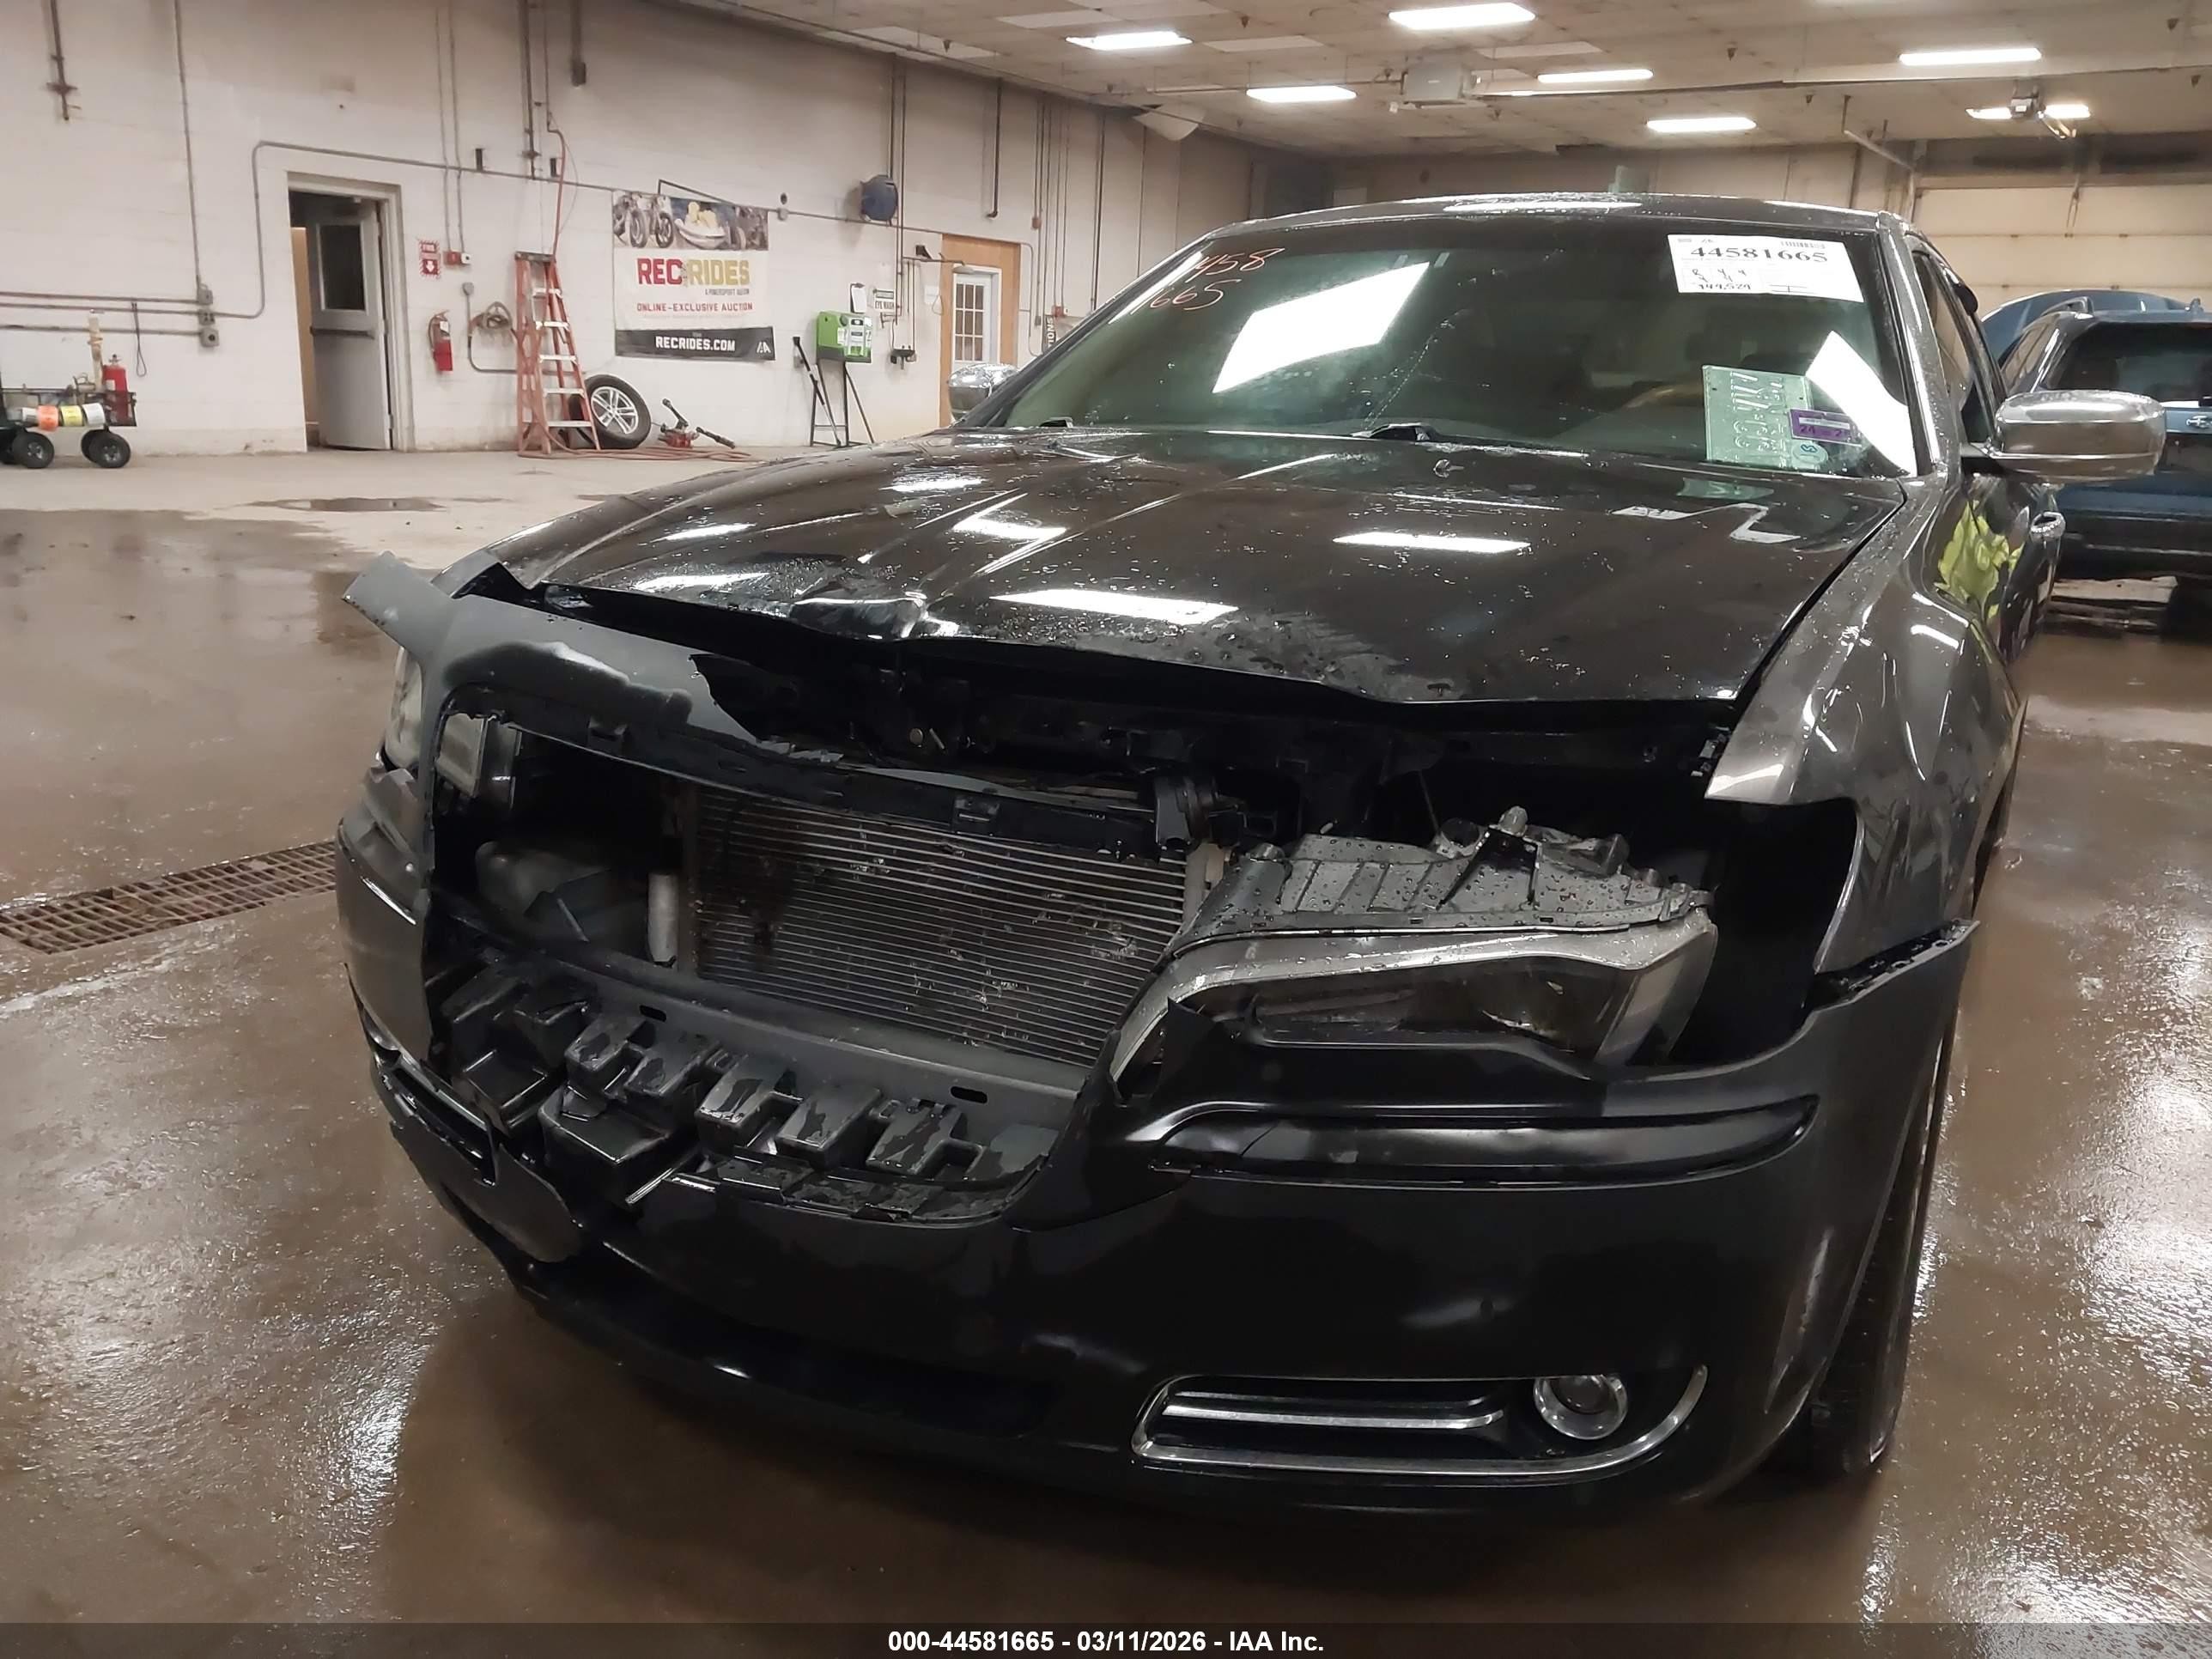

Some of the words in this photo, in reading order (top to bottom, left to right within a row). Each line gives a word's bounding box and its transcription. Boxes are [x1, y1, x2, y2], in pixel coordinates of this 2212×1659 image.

[1691, 246, 1828, 262] 44581665
[720, 301, 753, 312] AUCTION
[655, 336, 736, 351] RECRIDES.COM
